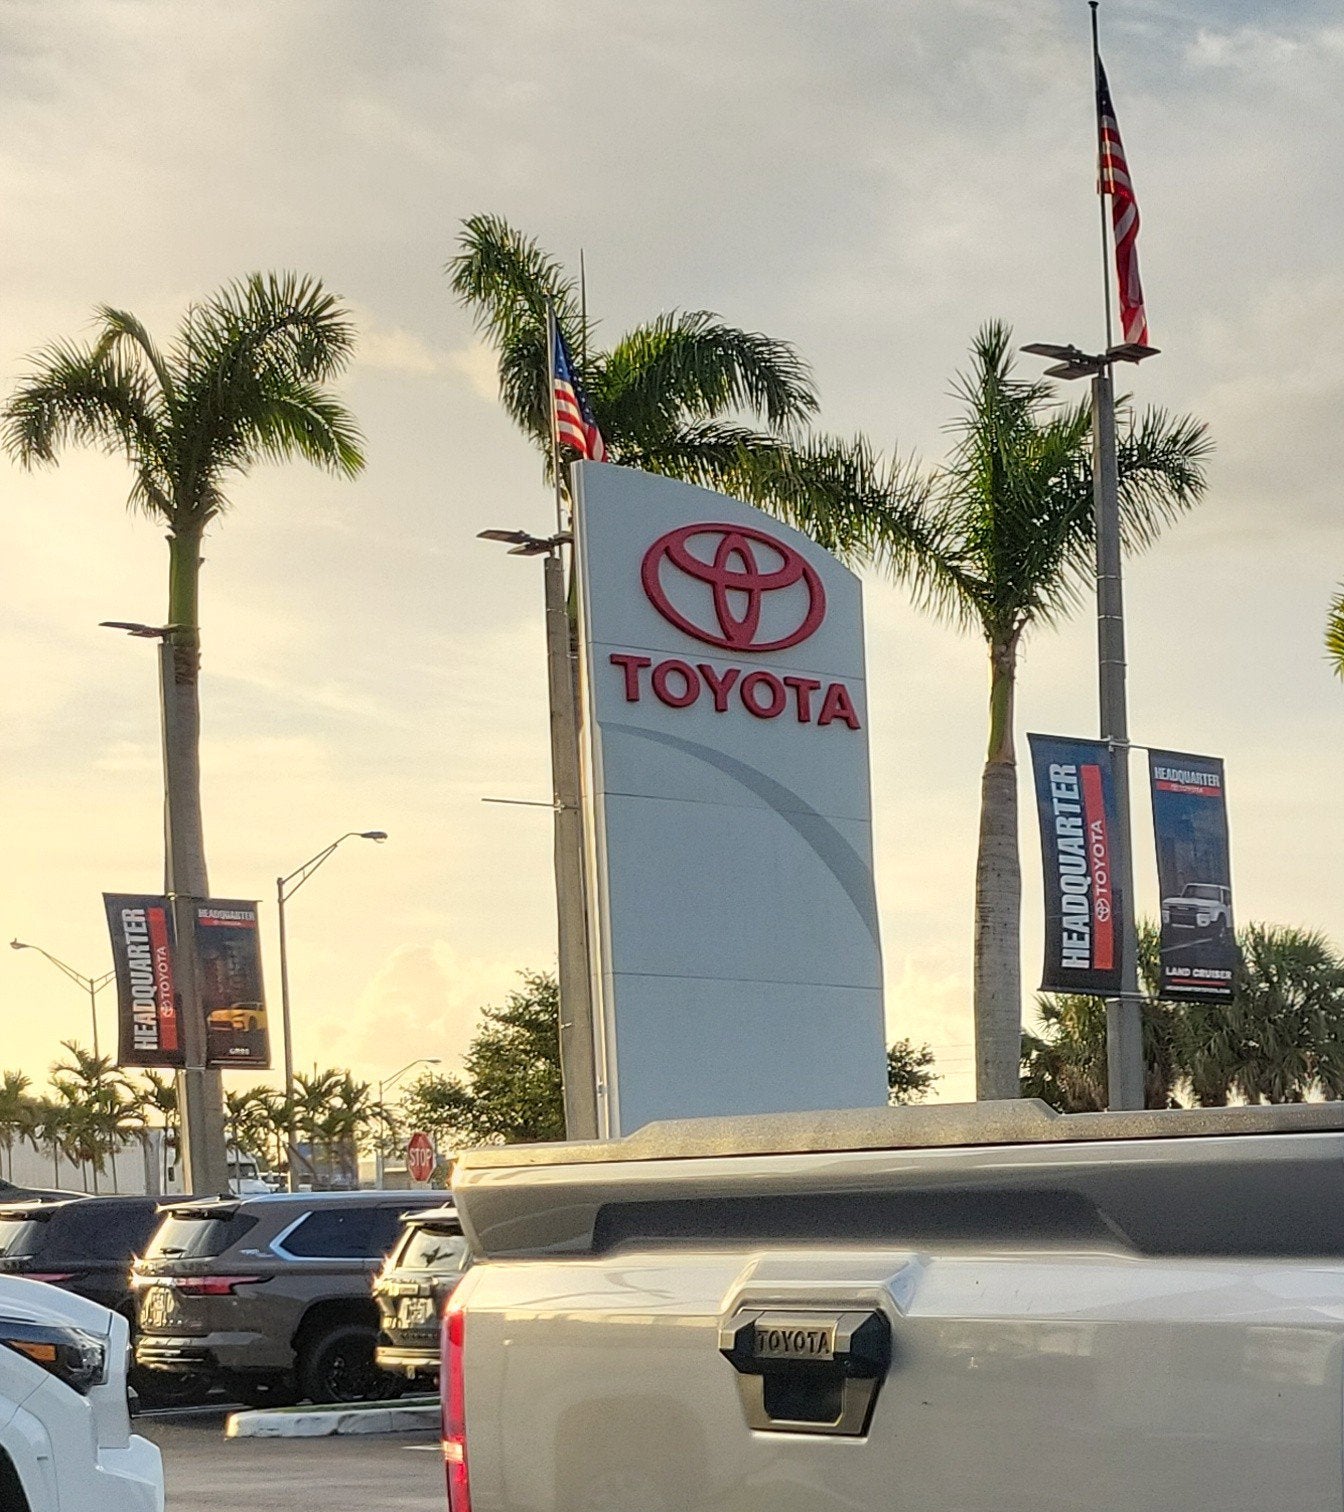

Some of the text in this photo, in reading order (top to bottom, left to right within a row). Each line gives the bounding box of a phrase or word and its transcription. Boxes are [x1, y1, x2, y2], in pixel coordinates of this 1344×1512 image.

[610, 653, 861, 730] TOYOTA
[1154, 767, 1220, 787] HEADQUARTER
[1050, 764, 1092, 969] HEADQUARTER
[1091, 820, 1108, 893] TOYOTA
[122, 908, 158, 1050] HEADQUARTER
[156, 946, 173, 1003] TOYOTA
[1165, 966, 1232, 979] LAND CRUISER
[409, 1147, 431, 1167] STOP
[757, 1329, 831, 1355] TOYOTA
